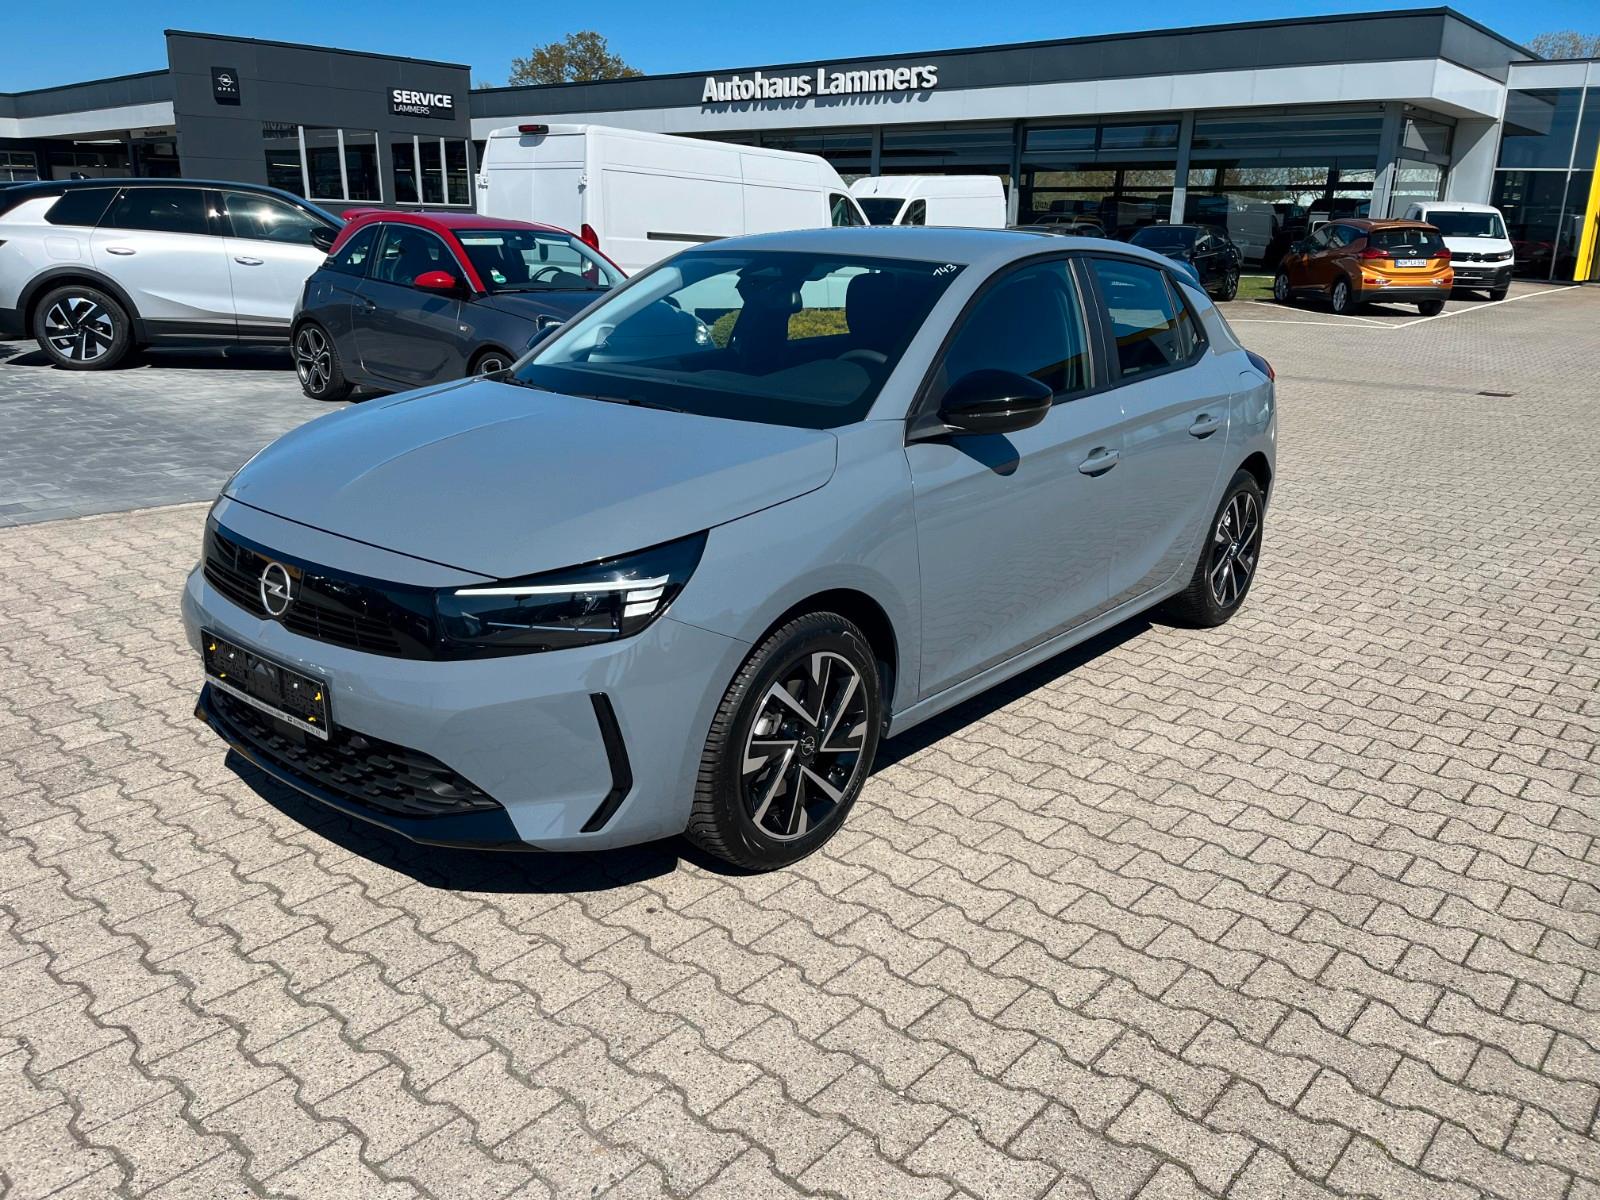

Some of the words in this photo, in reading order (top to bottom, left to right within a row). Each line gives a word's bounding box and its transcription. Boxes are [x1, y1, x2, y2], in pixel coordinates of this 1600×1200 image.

[702, 71, 811, 102] Autohaus
[817, 65, 938, 95] Lammers
[393, 90, 452, 108] SERVICE
[394, 104, 430, 114] LAMMERS
[933, 263, 957, 276] 143
